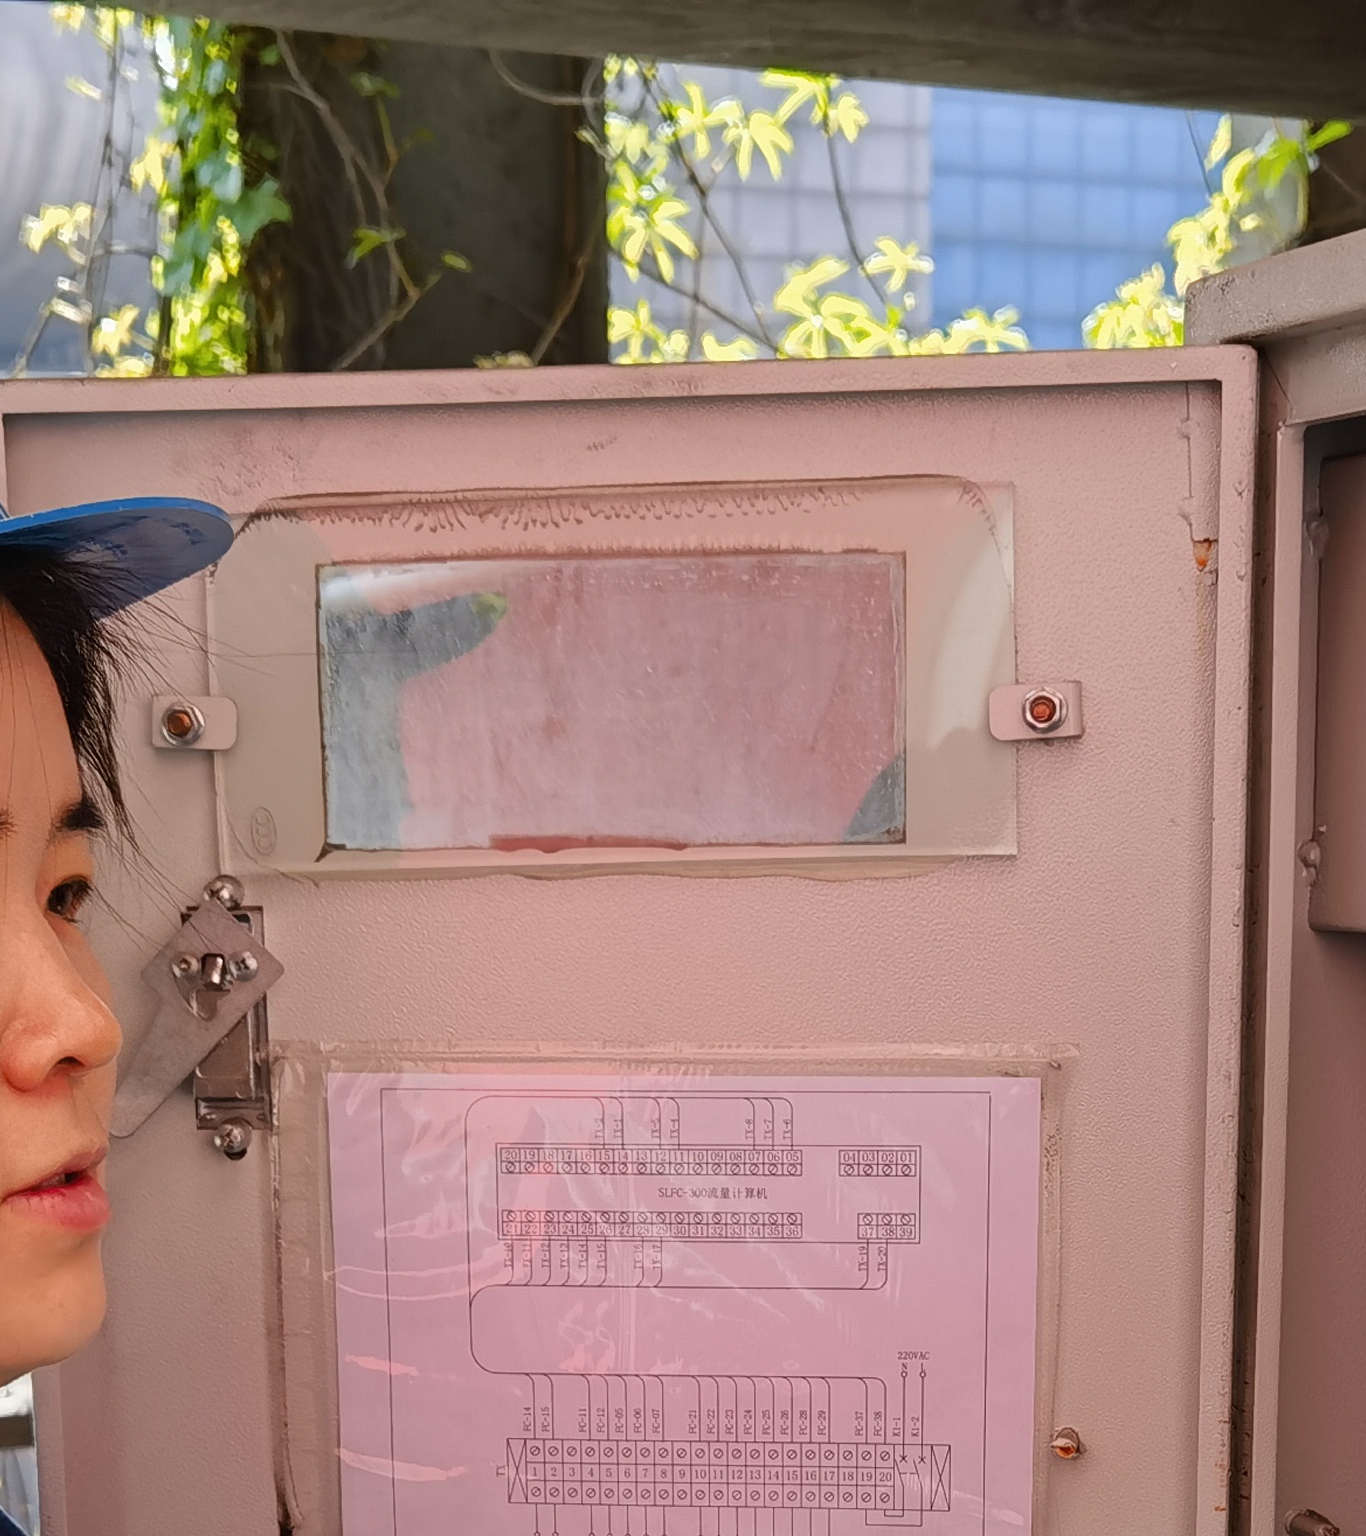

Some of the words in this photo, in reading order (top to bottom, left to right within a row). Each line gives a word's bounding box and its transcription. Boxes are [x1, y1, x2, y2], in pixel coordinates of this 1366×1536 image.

[745, 1118, 753, 1140] TX-8
[764, 1118, 772, 1140] TX-7
[504, 1150, 517, 1161] 20
[523, 1150, 535, 1161] 19
[543, 1150, 554, 1161] 18
[561, 1150, 572, 1161] 17
[580, 1150, 592, 1161] 16
[599, 1150, 610, 1161] 15
[618, 1150, 629, 1161] 14
[636, 1150, 648, 1161] 13
[655, 1151, 666, 1162] 12
[674, 1151, 684, 1162] 11
[692, 1151, 704, 1162] 10
[710, 1151, 723, 1162] 09
[729, 1151, 742, 1162] 08
[748, 1151, 761, 1162] 07
[767, 1151, 780, 1162] 06
[786, 1151, 799, 1162] 05
[843, 1152, 856, 1163] 04
[862, 1152, 875, 1163] 03
[881, 1152, 894, 1163] 02
[900, 1152, 913, 1163] 01
[658, 1187, 768, 1200] SLFC-300流量计算机
[506, 1224, 517, 1235] 21
[524, 1224, 537, 1235] 22
[544, 1224, 556, 1235] 23
[563, 1224, 574, 1235] 24
[581, 1224, 593, 1235] 25
[600, 1224, 612, 1235] 26
[618, 1224, 631, 1235] 27
[637, 1224, 649, 1235] 28
[655, 1225, 668, 1236] 29
[674, 1225, 686, 1236] 30
[692, 1225, 704, 1236] 31
[711, 1225, 723, 1236] 32
[729, 1225, 742, 1236] 33
[748, 1225, 761, 1236] 34
[767, 1225, 780, 1236] 35
[786, 1225, 799, 1236] 36
[861, 1227, 874, 1237] 37
[881, 1227, 895, 1237] 38
[899, 1227, 913, 1237] 39
[897, 1351, 930, 1360] 220VAC
[523, 1406, 532, 1432] FC-14
[541, 1406, 550, 1432] FC-15
[578, 1408, 587, 1433] FC-11
[596, 1407, 605, 1433] FC-12
[688, 1410, 697, 1434] FC-21
[707, 1409, 715, 1434] FC-22
[725, 1409, 734, 1435] FC-23
[743, 1409, 752, 1435] FC-24
[817, 1410, 826, 1436] FC-29
[855, 1411, 864, 1436] FC-37
[532, 1467, 537, 1477] 1
[550, 1467, 558, 1477] 2
[569, 1467, 576, 1477] 3
[588, 1467, 595, 1477] 4
[605, 1468, 612, 1478] 5
[624, 1468, 631, 1478] 6
[642, 1468, 649, 1478] 7
[660, 1469, 667, 1479] 8
[679, 1469, 685, 1479] 9
[695, 1469, 706, 1480] 10
[713, 1469, 724, 1480] 11
[731, 1469, 743, 1480] 12
[750, 1469, 762, 1480] 13
[768, 1470, 779, 1481] 14
[787, 1470, 798, 1481] 15
[805, 1470, 817, 1481] 16
[824, 1470, 835, 1481] 17
[842, 1471, 854, 1482] 18
[861, 1471, 873, 1482] 19
[879, 1471, 892, 1482] 20
